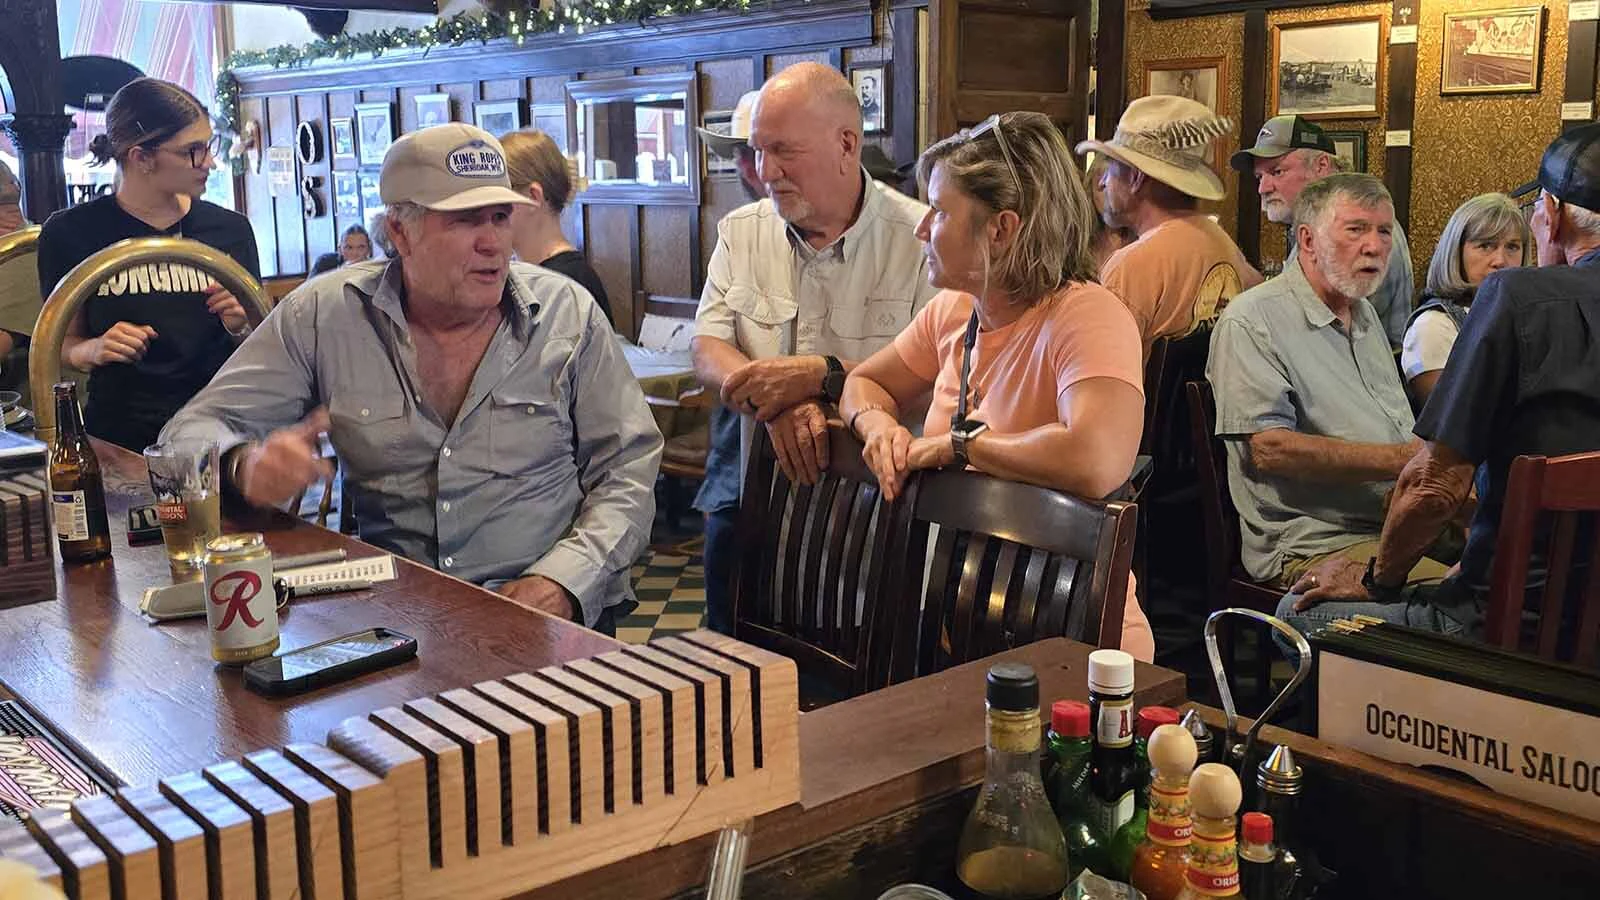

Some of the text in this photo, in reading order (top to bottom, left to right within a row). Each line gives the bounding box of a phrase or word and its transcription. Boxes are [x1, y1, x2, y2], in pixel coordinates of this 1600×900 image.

[452, 152, 476, 166] KING
[210, 570, 265, 632] R
[1366, 703, 1514, 774] OCCIDENTAL
